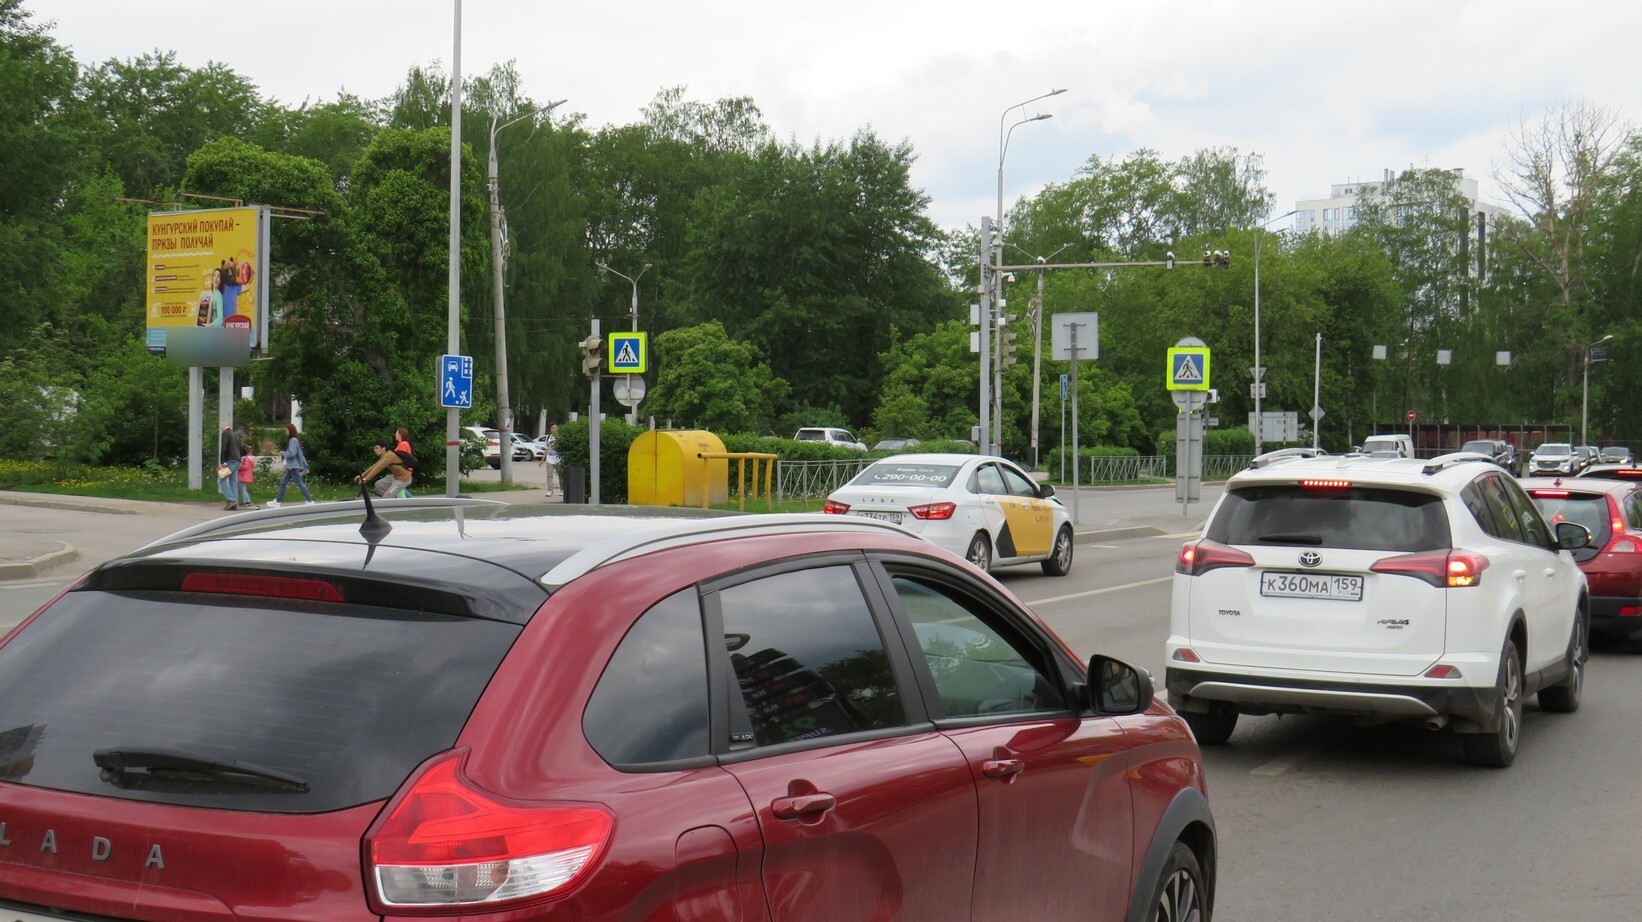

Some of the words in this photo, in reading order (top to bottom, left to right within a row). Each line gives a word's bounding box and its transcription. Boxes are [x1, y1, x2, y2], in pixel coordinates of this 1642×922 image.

[152, 219, 198, 236] КУНГУРСКИЙ
[199, 217, 234, 233] ПОКУПАЙ
[152, 237, 177, 250] ПРИЗЫ
[180, 233, 214, 249] ПОЛУЧАЙ
[881, 473, 947, 482] 290-00-00
[1267, 576, 1329, 593] К360МА
[1334, 578, 1358, 590] 159
[0, 822, 165, 870] LADA
